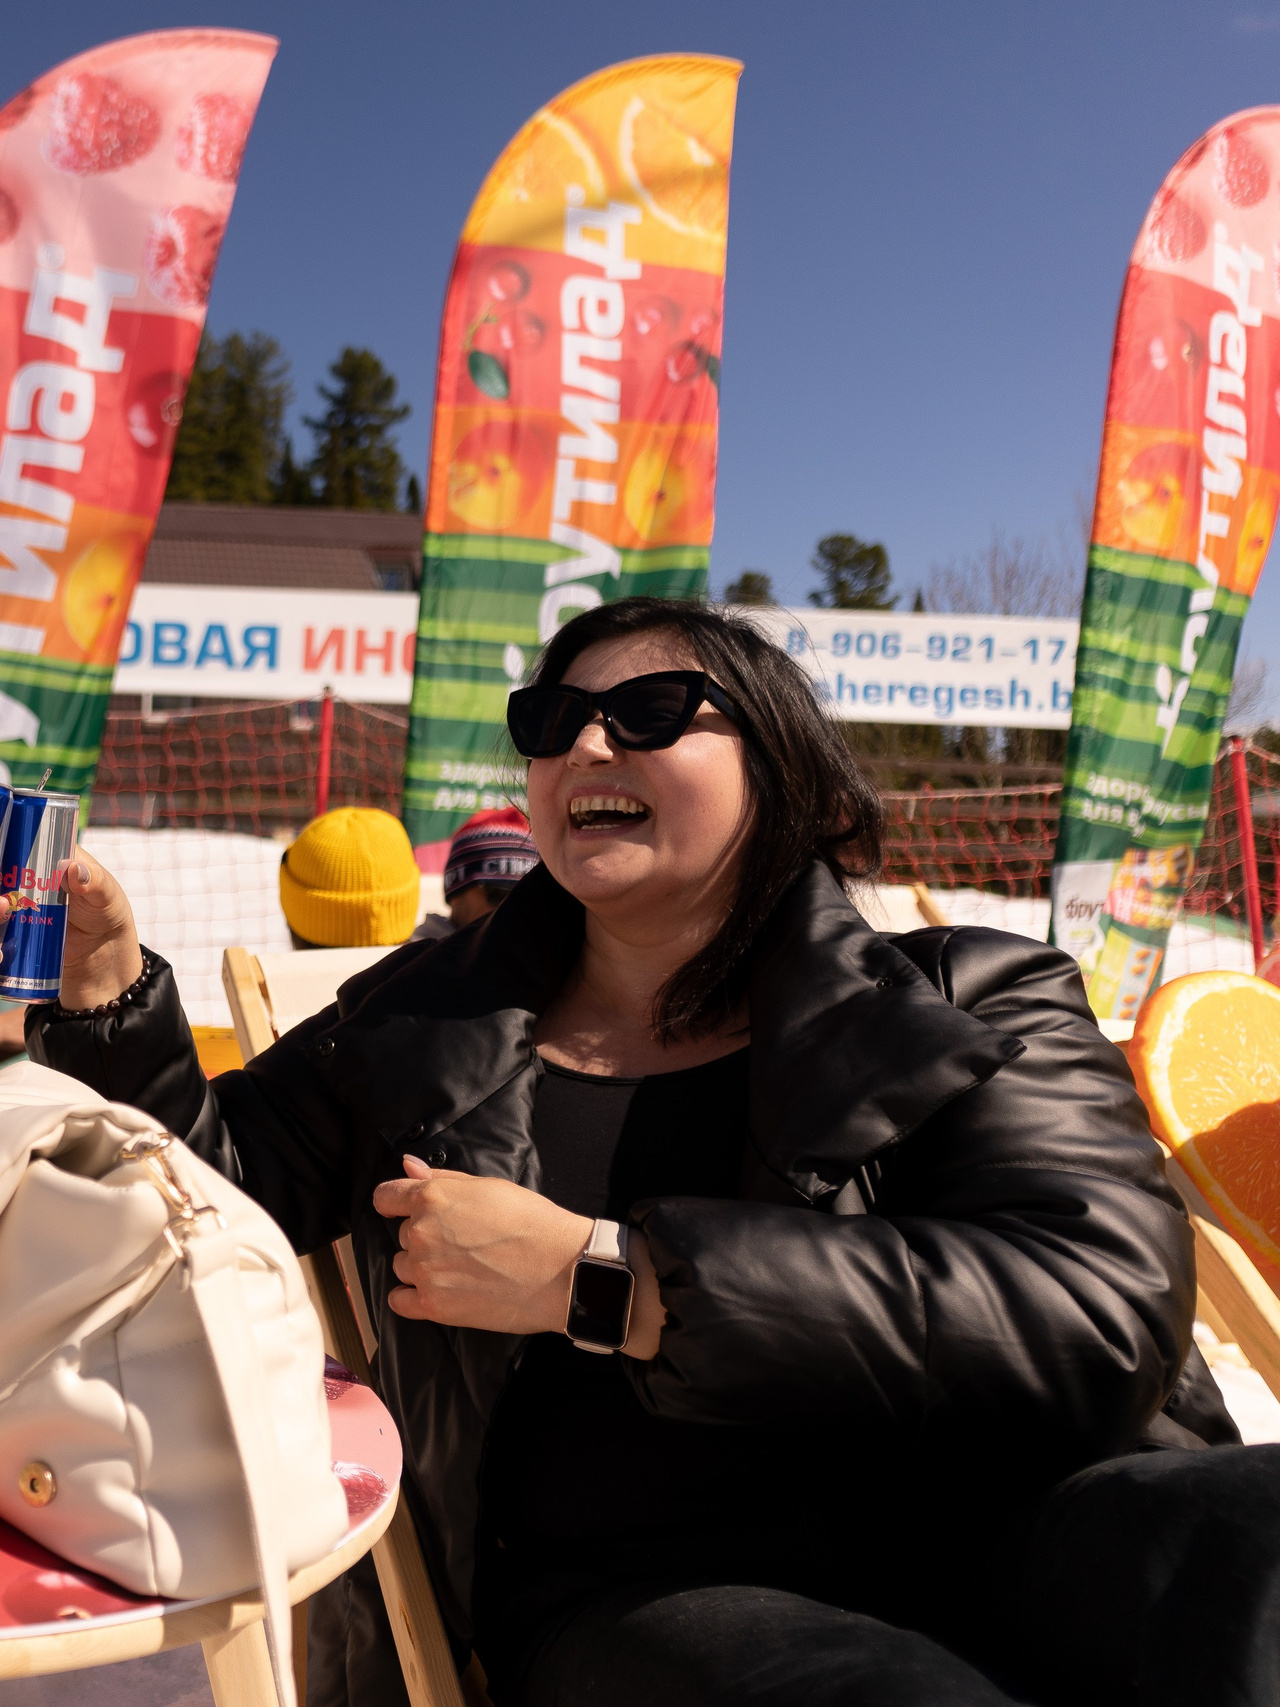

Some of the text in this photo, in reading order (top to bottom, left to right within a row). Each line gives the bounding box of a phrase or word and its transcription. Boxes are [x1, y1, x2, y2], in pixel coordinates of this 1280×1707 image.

[120, 620, 280, 670] ОВАЯ
[786, 628, 1076, 664] 8-906-921-17
[20, 868, 62, 892] Bull
[20, 916, 53, 926] DRINK
